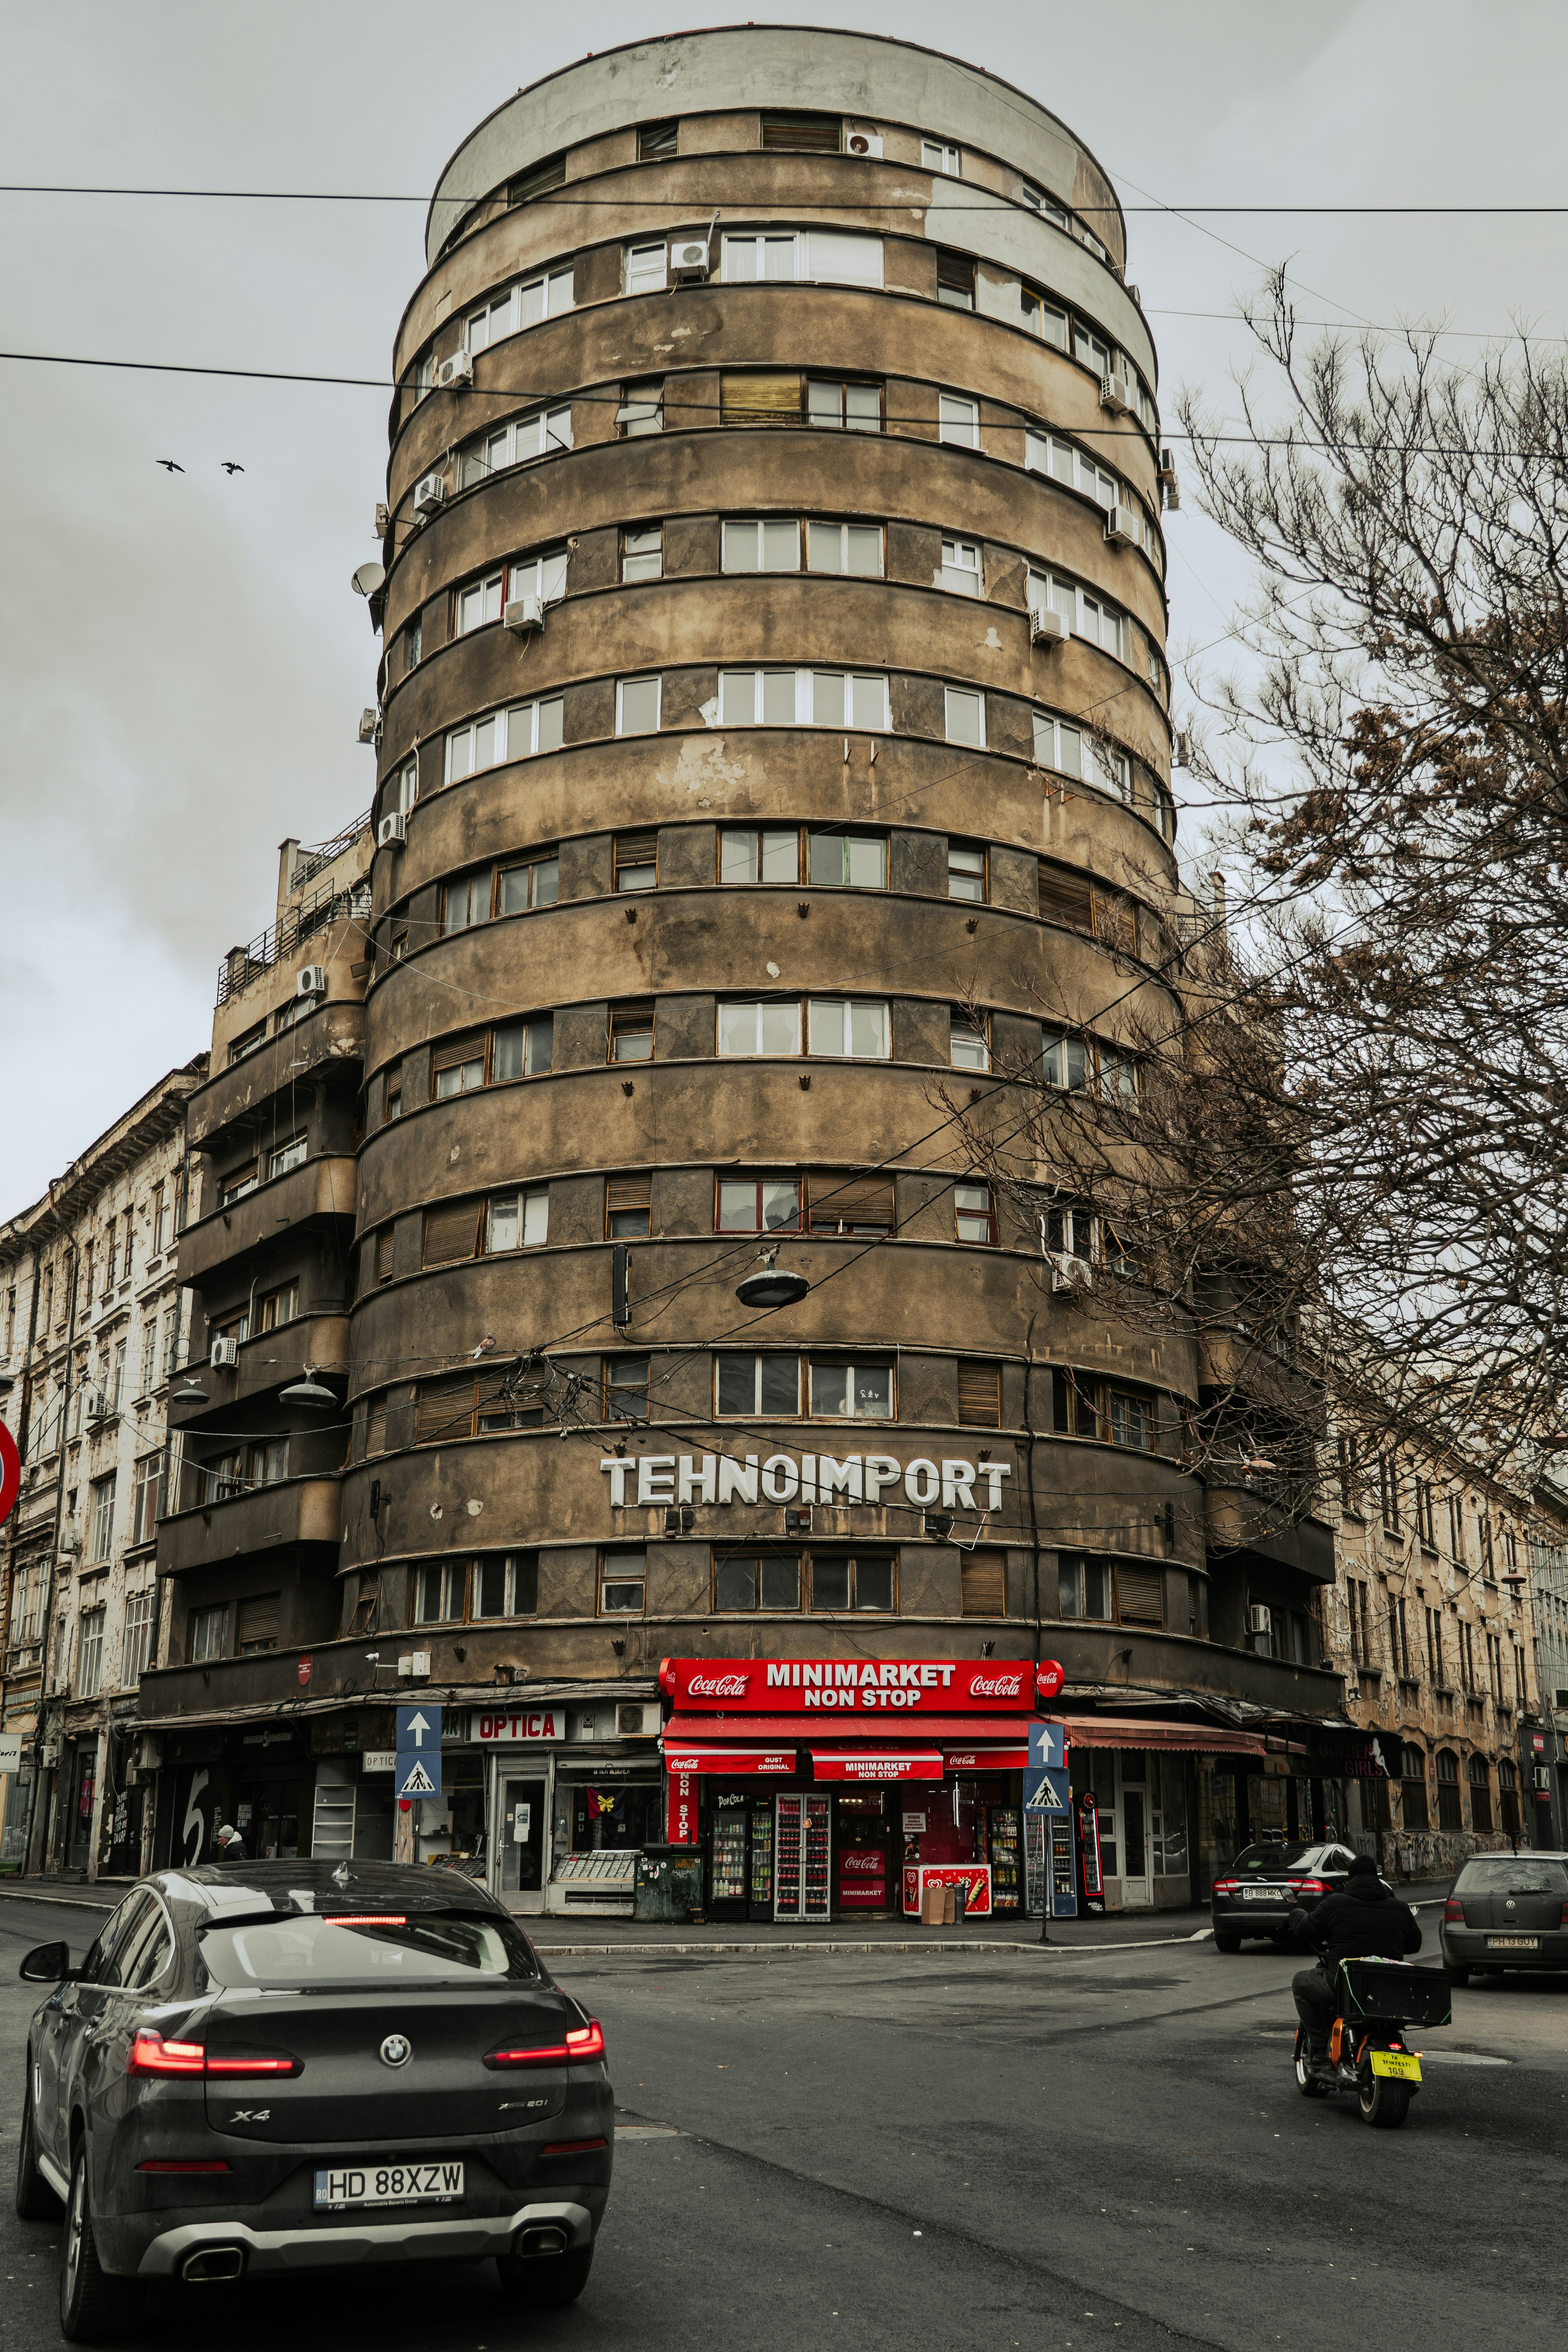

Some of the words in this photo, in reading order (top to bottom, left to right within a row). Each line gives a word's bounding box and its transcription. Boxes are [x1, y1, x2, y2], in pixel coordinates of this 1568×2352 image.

[600, 1454, 1011, 1512] TEHNOIMPORT
[767, 1664, 955, 1687] MINIMARKET
[1037, 1672, 1057, 1685] Coca-Cola
[688, 1674, 749, 1696] Coca-Cola
[970, 1673, 1023, 1696] Coca-Cola
[805, 1689, 854, 1706] NON
[862, 1689, 921, 1707] STOP
[480, 1713, 555, 1739] OPTICA
[1319, 1742, 1373, 1759] GOLDEN
[367, 1756, 396, 1767] OPTIC
[671, 1759, 699, 1769] Coca-Cola
[846, 1762, 911, 1771] MINIMARKET
[950, 1755, 976, 1765] Coca-Cola
[1345, 1760, 1383, 1777] GIRLS
[680, 1773, 689, 1796] NON
[679, 1805, 689, 1838] STOP
[846, 1856, 879, 1869] Coca-Cola
[1493, 1937, 1505, 1945] PH
[1507, 1937, 1515, 1945] 13
[1517, 1937, 1536, 1945] GUY
[1388, 2067, 1404, 2075] 169
[229, 2110, 270, 2123] X4
[330, 2171, 365, 2199] HD
[376, 2164, 461, 2195] 88XZW
[316, 2188, 327, 2200] RO
